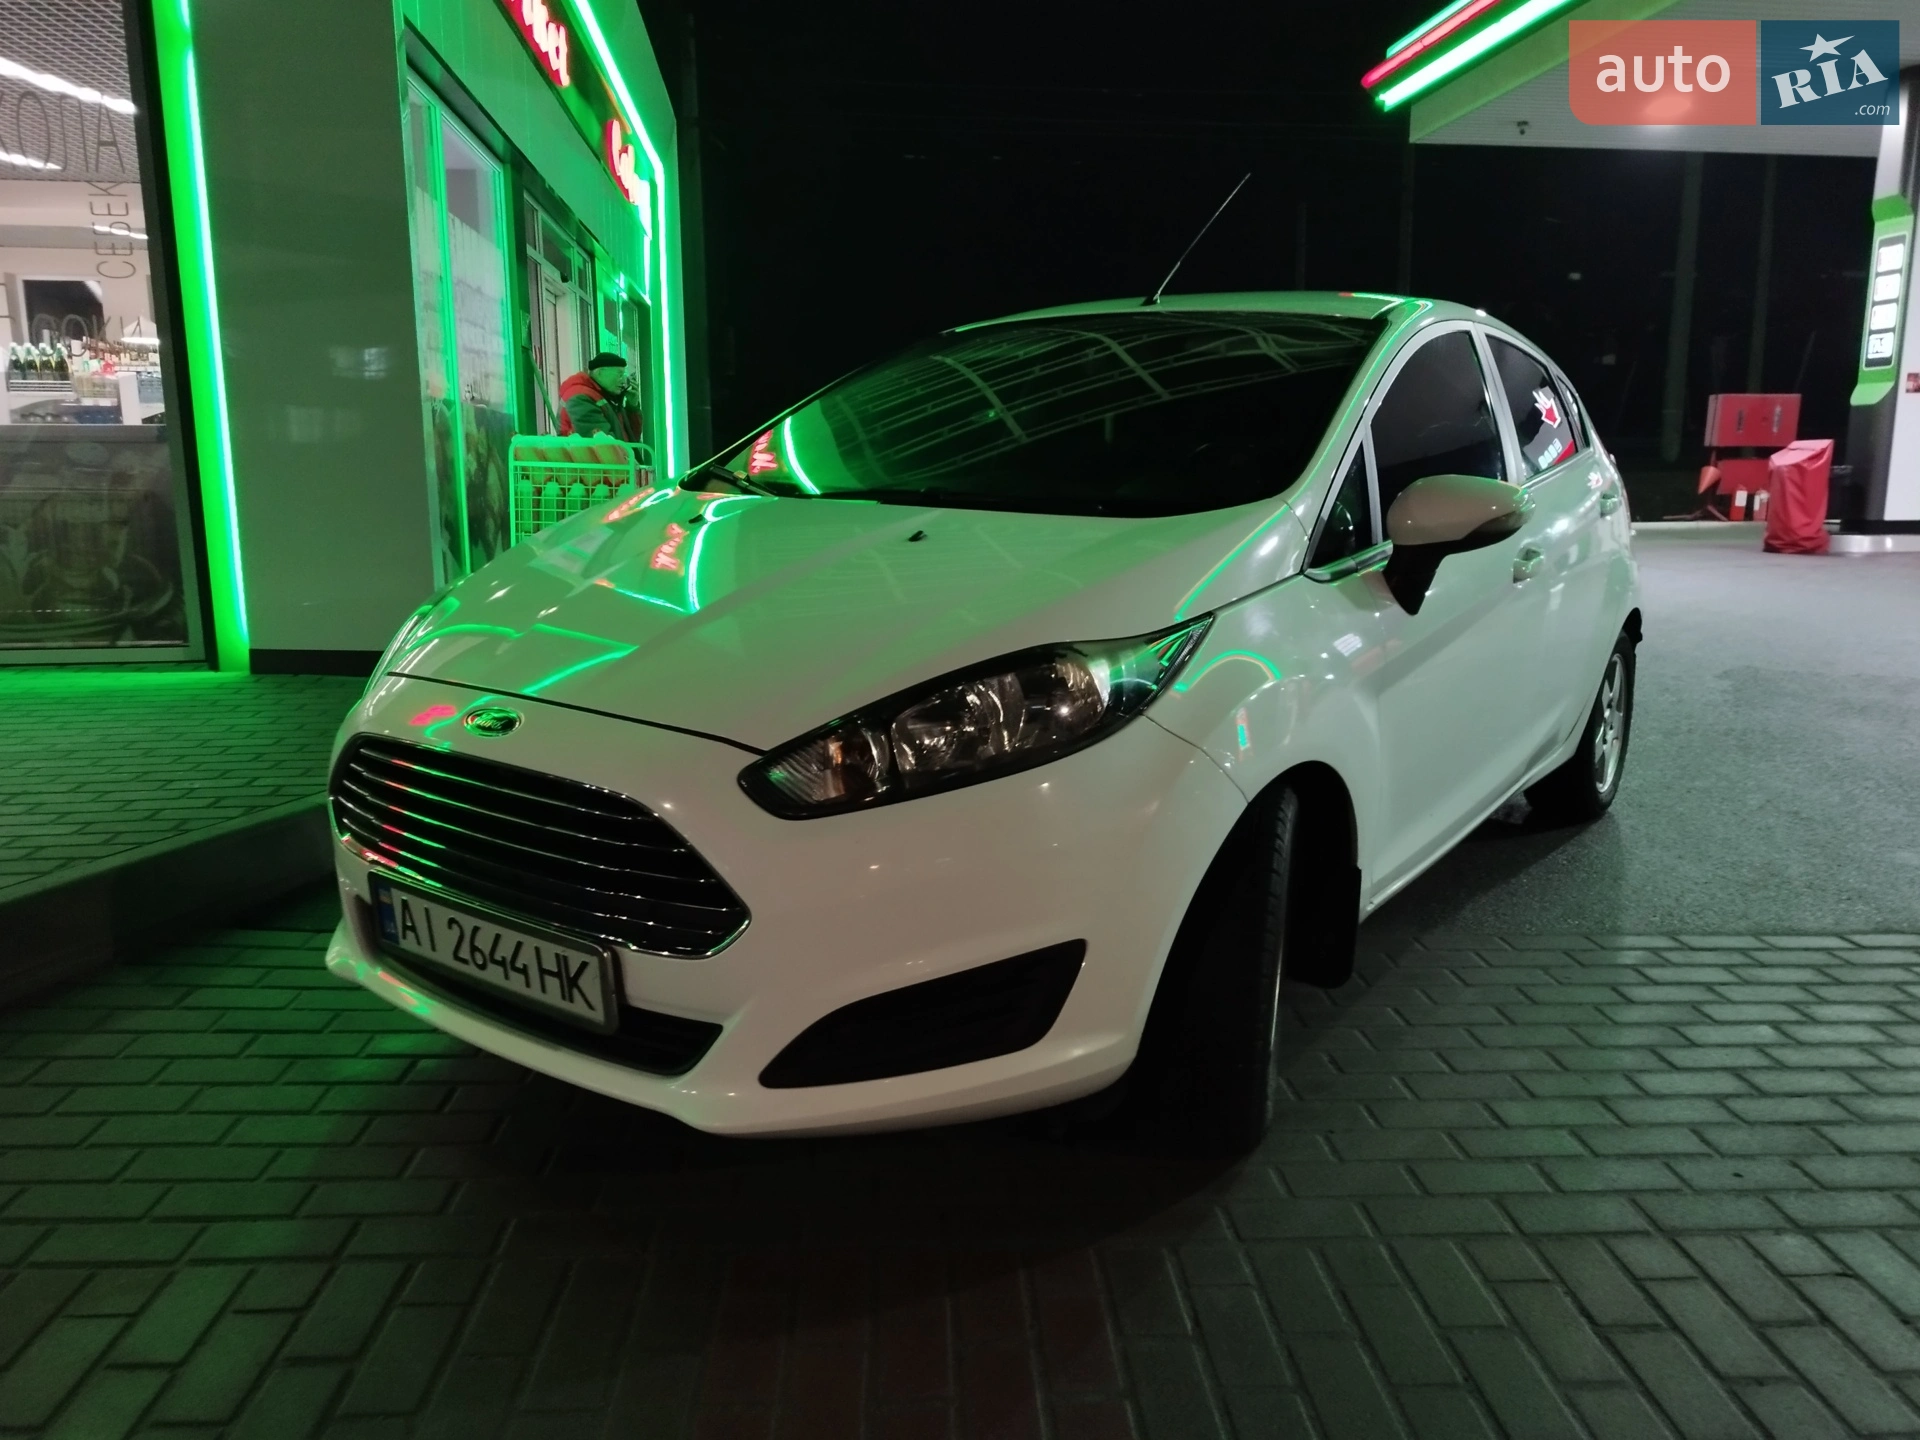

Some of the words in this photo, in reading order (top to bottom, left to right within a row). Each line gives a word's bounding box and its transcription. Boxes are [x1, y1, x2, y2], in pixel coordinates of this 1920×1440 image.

[401, 897, 436, 952] AI
[447, 916, 531, 988] 2644
[534, 945, 596, 1012] HK
